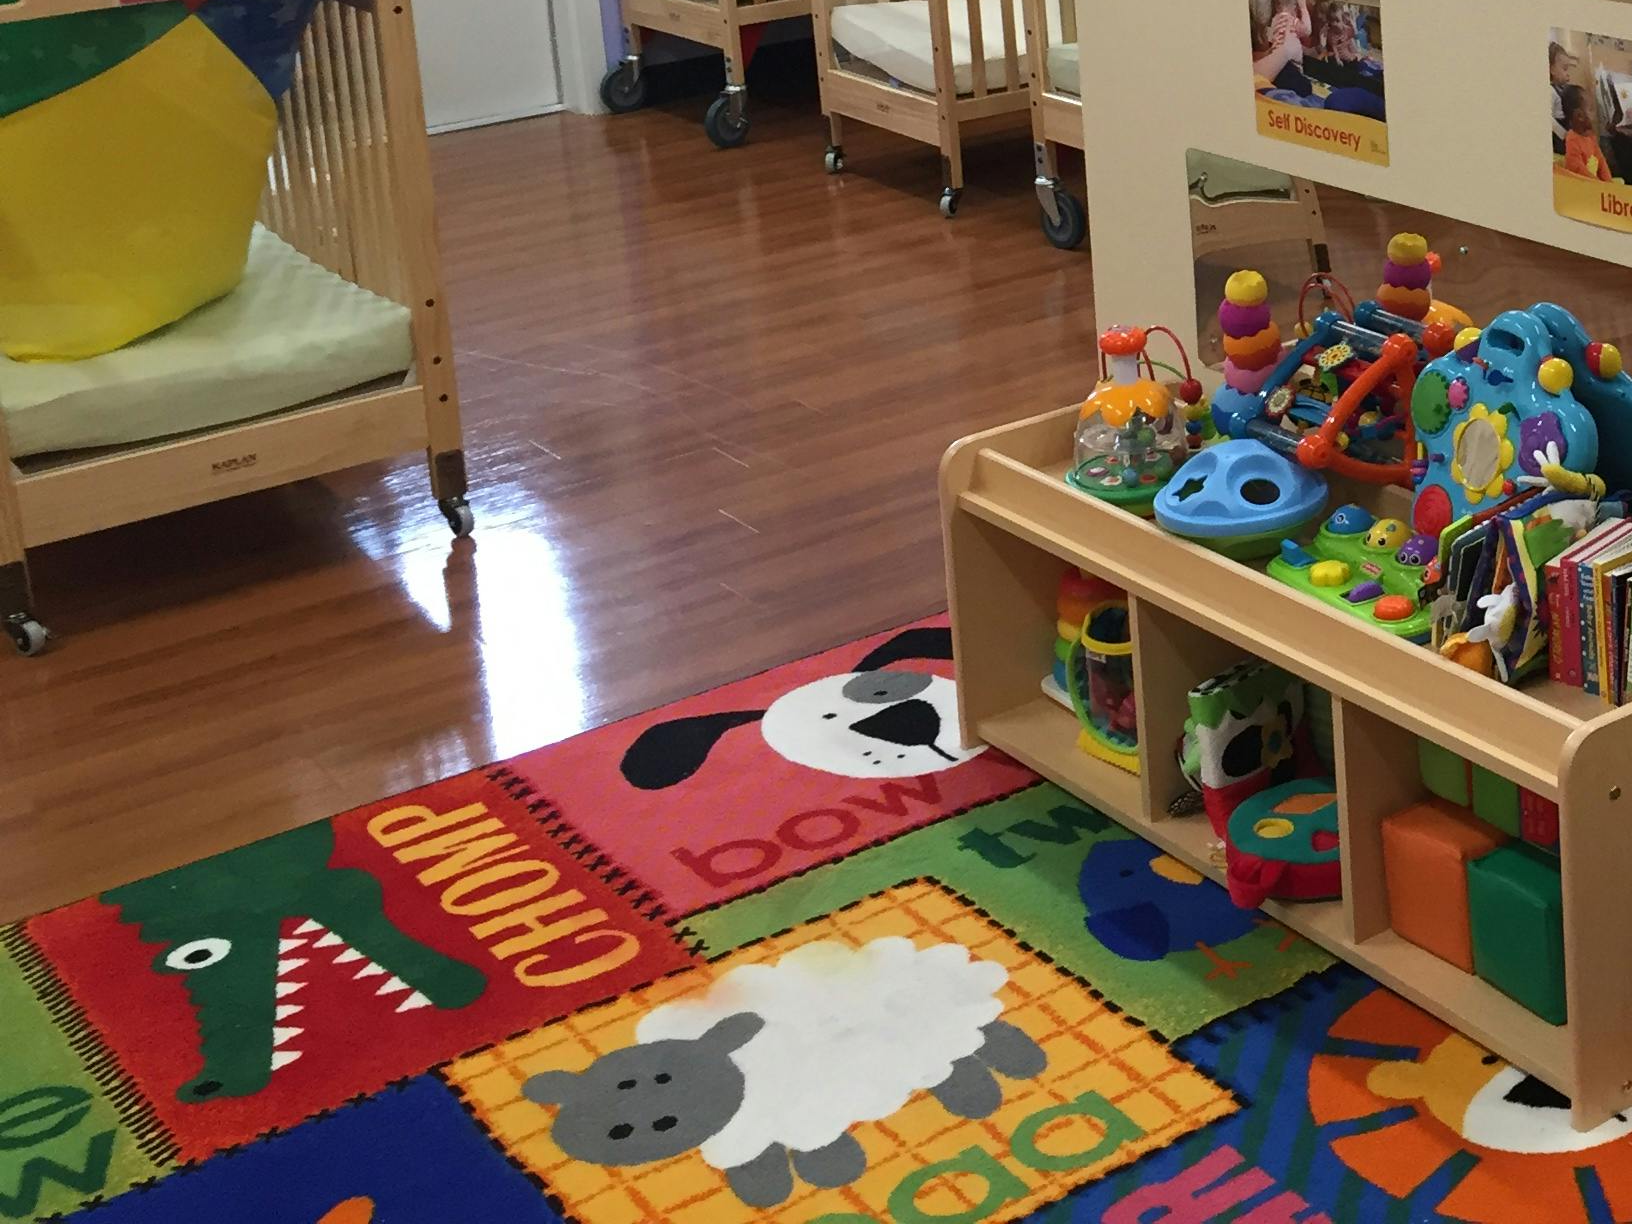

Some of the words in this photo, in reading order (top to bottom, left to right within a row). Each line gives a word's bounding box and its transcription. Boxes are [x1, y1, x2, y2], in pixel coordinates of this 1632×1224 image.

[1267, 109, 1291, 131] Self
[1294, 112, 1361, 152] Discovery
[669, 772, 945, 889] bow
[366, 802, 641, 988] CHOMP
